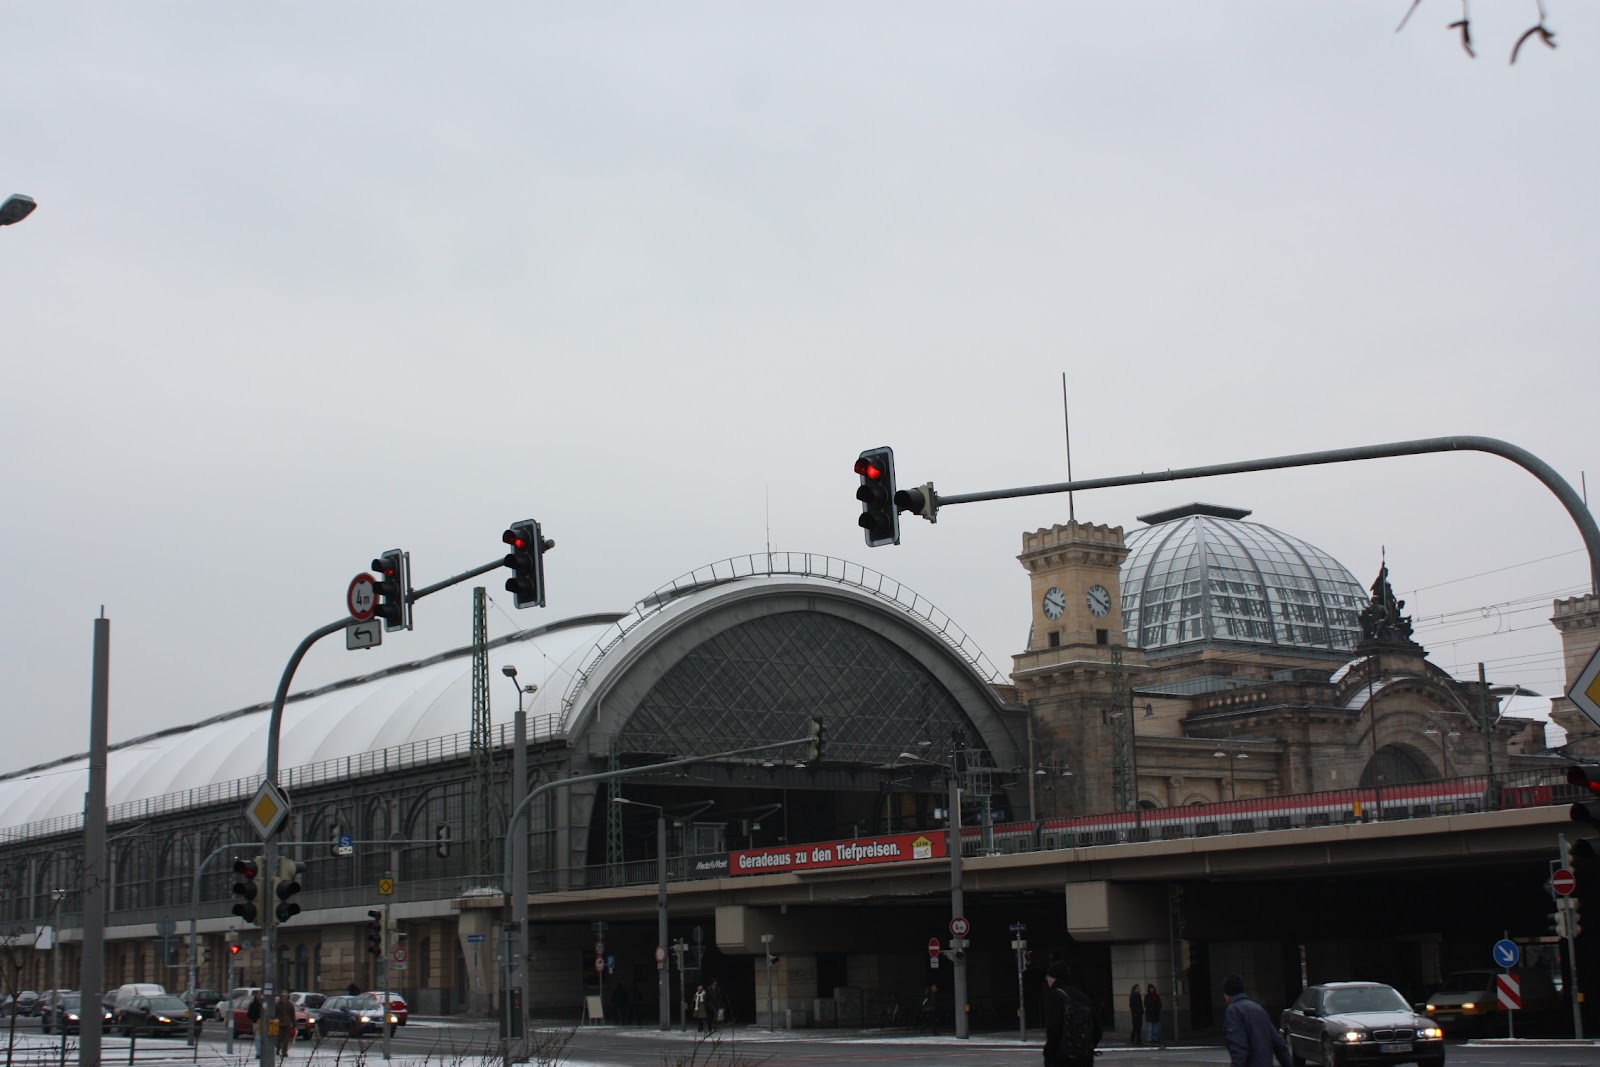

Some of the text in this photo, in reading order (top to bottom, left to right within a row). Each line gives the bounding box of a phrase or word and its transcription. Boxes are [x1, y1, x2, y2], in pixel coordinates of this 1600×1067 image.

[356, 589, 370, 605] 4 m
[340, 836, 350, 847] S
[739, 852, 791, 869] Geradeaus
[795, 851, 807, 864] zu
[812, 847, 831, 862] den
[836, 841, 900, 862] Tiefpreisen.
